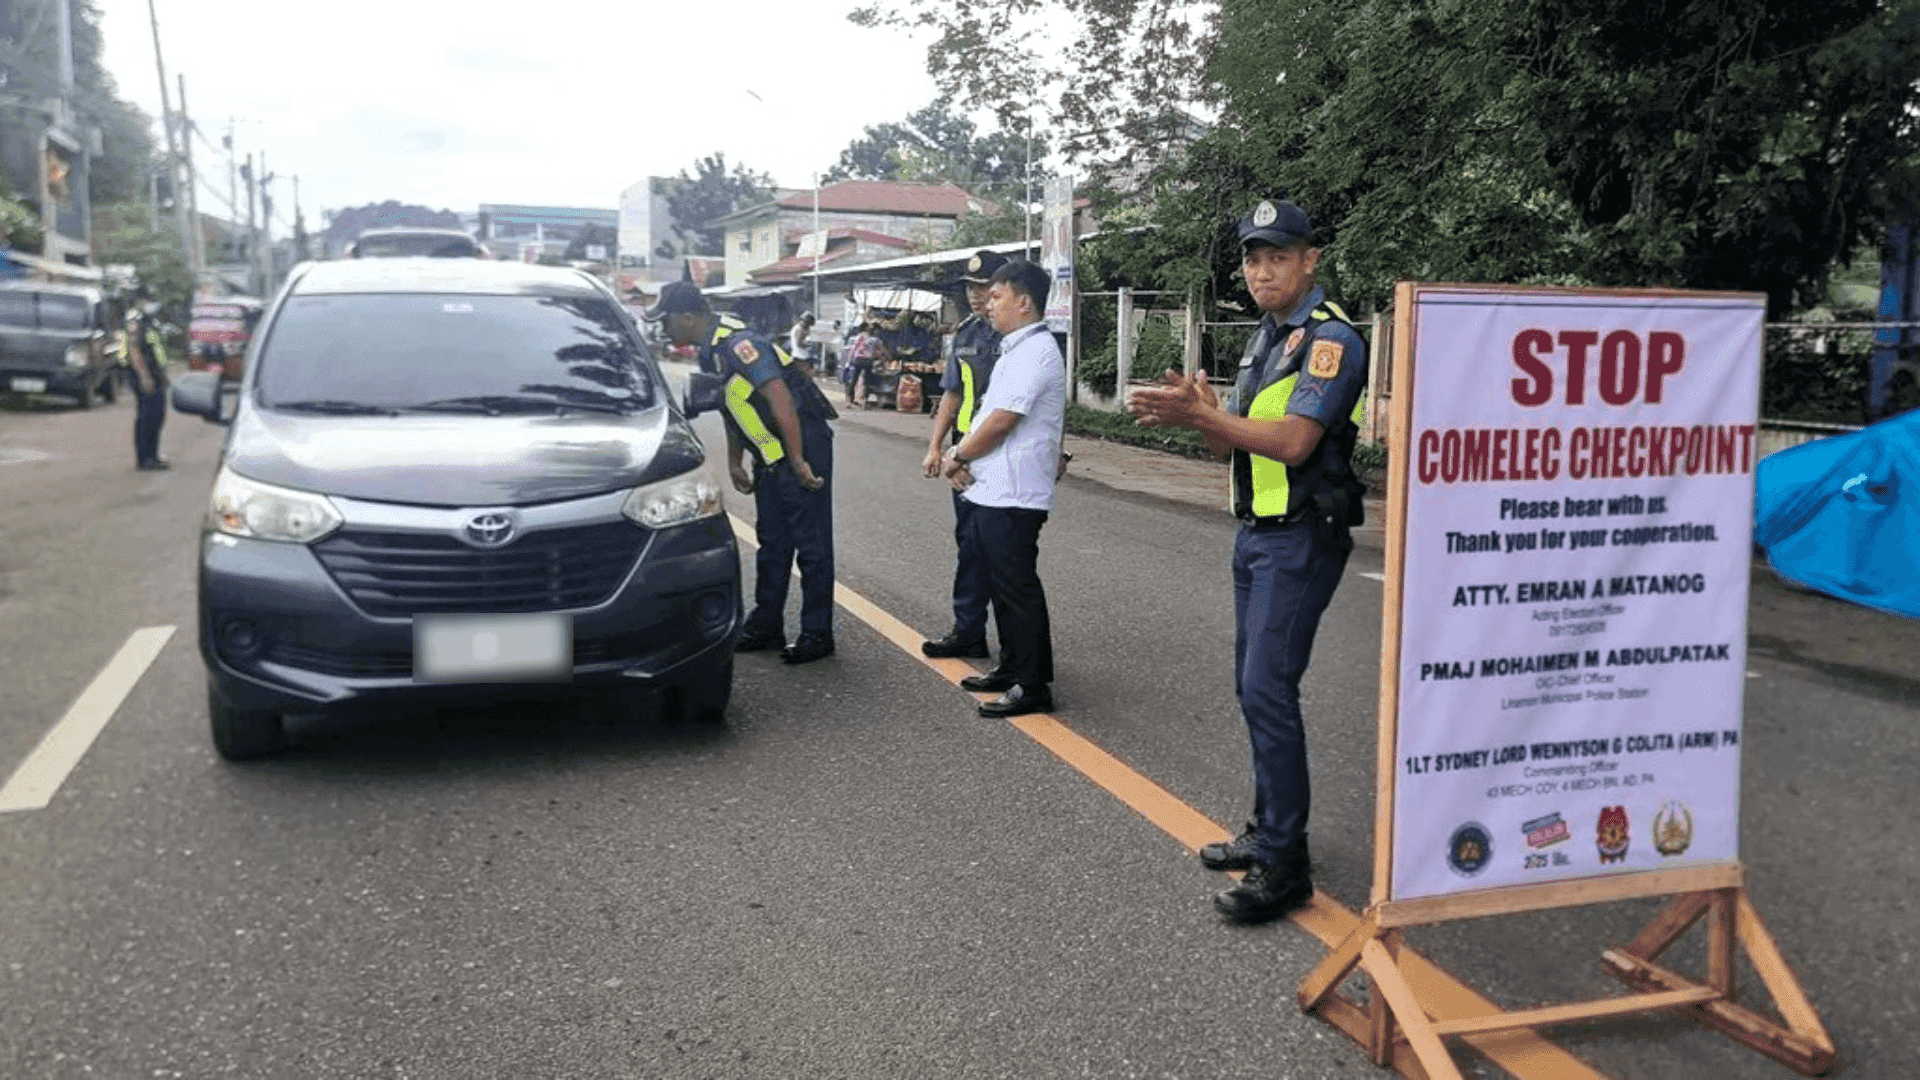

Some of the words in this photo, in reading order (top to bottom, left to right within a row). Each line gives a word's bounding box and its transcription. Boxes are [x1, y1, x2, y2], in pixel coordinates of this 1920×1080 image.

[1512, 327, 1686, 408] STOP
[1417, 426, 1562, 485] COMELEC
[1569, 424, 1755, 480] CHECKPOINT
[1500, 497, 1560, 521] Please
[1564, 496, 1604, 518] bear
[1607, 494, 1645, 516] with
[1446, 531, 1502, 554] Thank
[1505, 530, 1538, 554] you
[1541, 528, 1566, 550] for
[1569, 529, 1609, 550] your
[1611, 522, 1719, 548] cooperation.
[1452, 584, 1511, 607] ATTY.
[1516, 580, 1586, 604] EMRAN
[1591, 579, 1605, 599] A
[1609, 573, 1705, 597] MATANOG
[1420, 661, 1475, 681] PMAJ
[1480, 651, 1580, 677] MOHAIMEN
[1584, 650, 1599, 667] M
[1606, 643, 1731, 667] ABDULPATAK
[1405, 754, 1432, 775] 1LT
[1434, 748, 1491, 772] SYDNEY
[1492, 744, 1527, 766] LORD
[1530, 738, 1609, 761] WENNYSON
